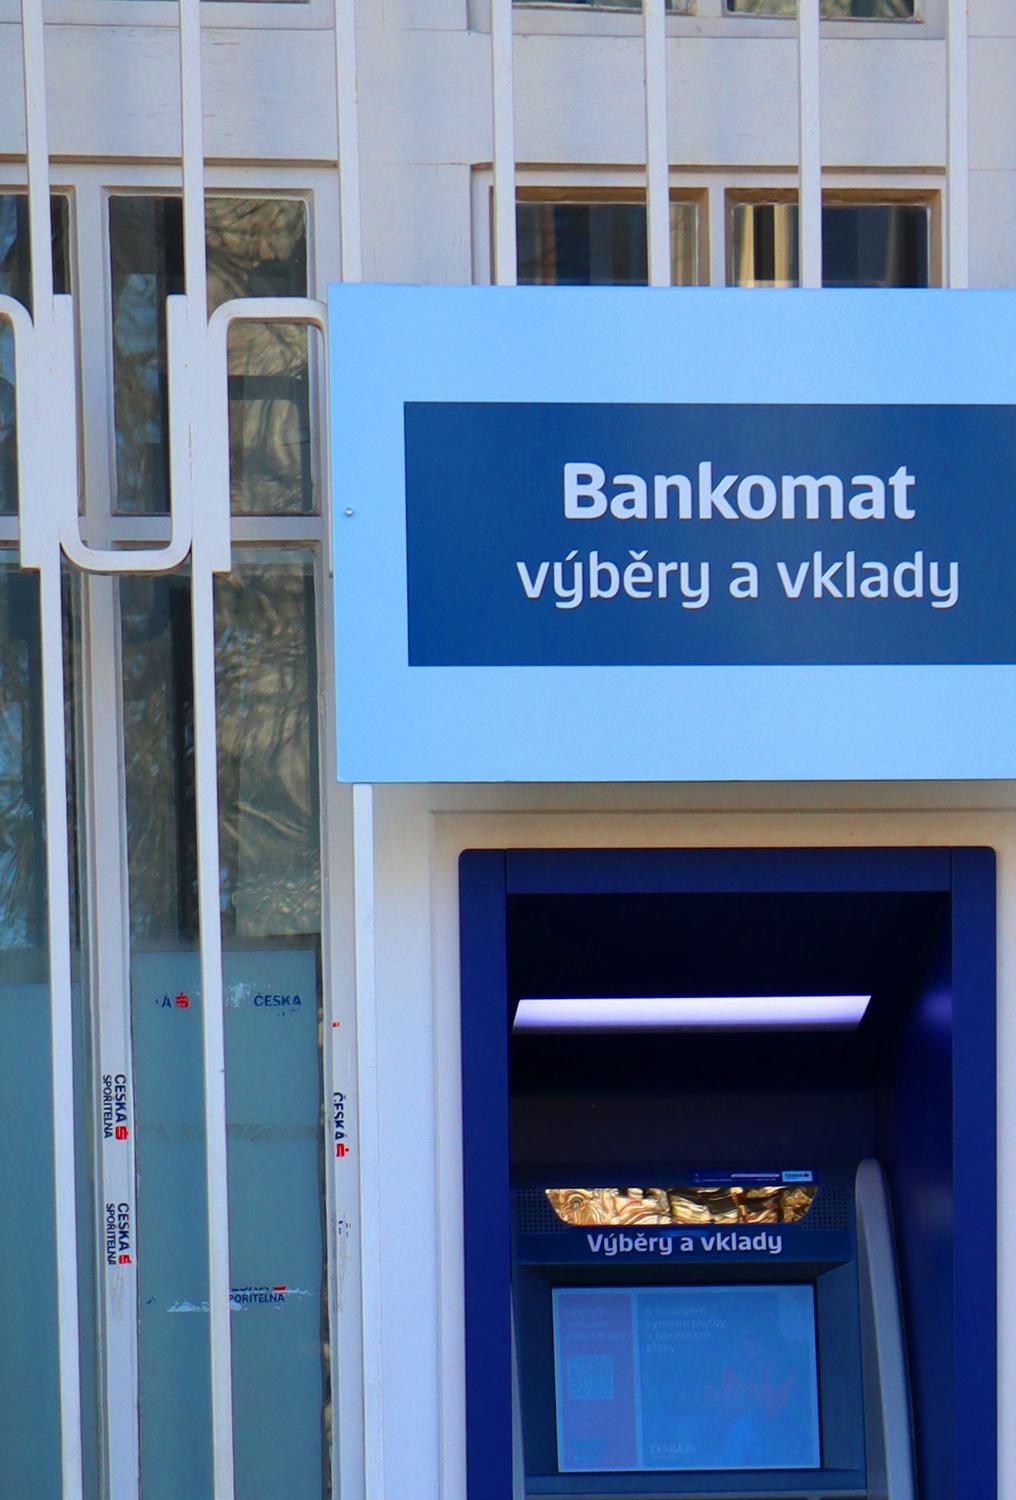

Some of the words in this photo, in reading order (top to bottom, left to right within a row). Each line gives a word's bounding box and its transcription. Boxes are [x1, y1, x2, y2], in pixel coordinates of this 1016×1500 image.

[564, 461, 916, 520] Bankomat
[516, 549, 709, 609] výběry
[729, 561, 759, 598] a
[777, 550, 960, 609] vklady
[586, 1232, 673, 1256] Výběry
[679, 1236, 694, 1251] a
[700, 1231, 782, 1255] vklady
